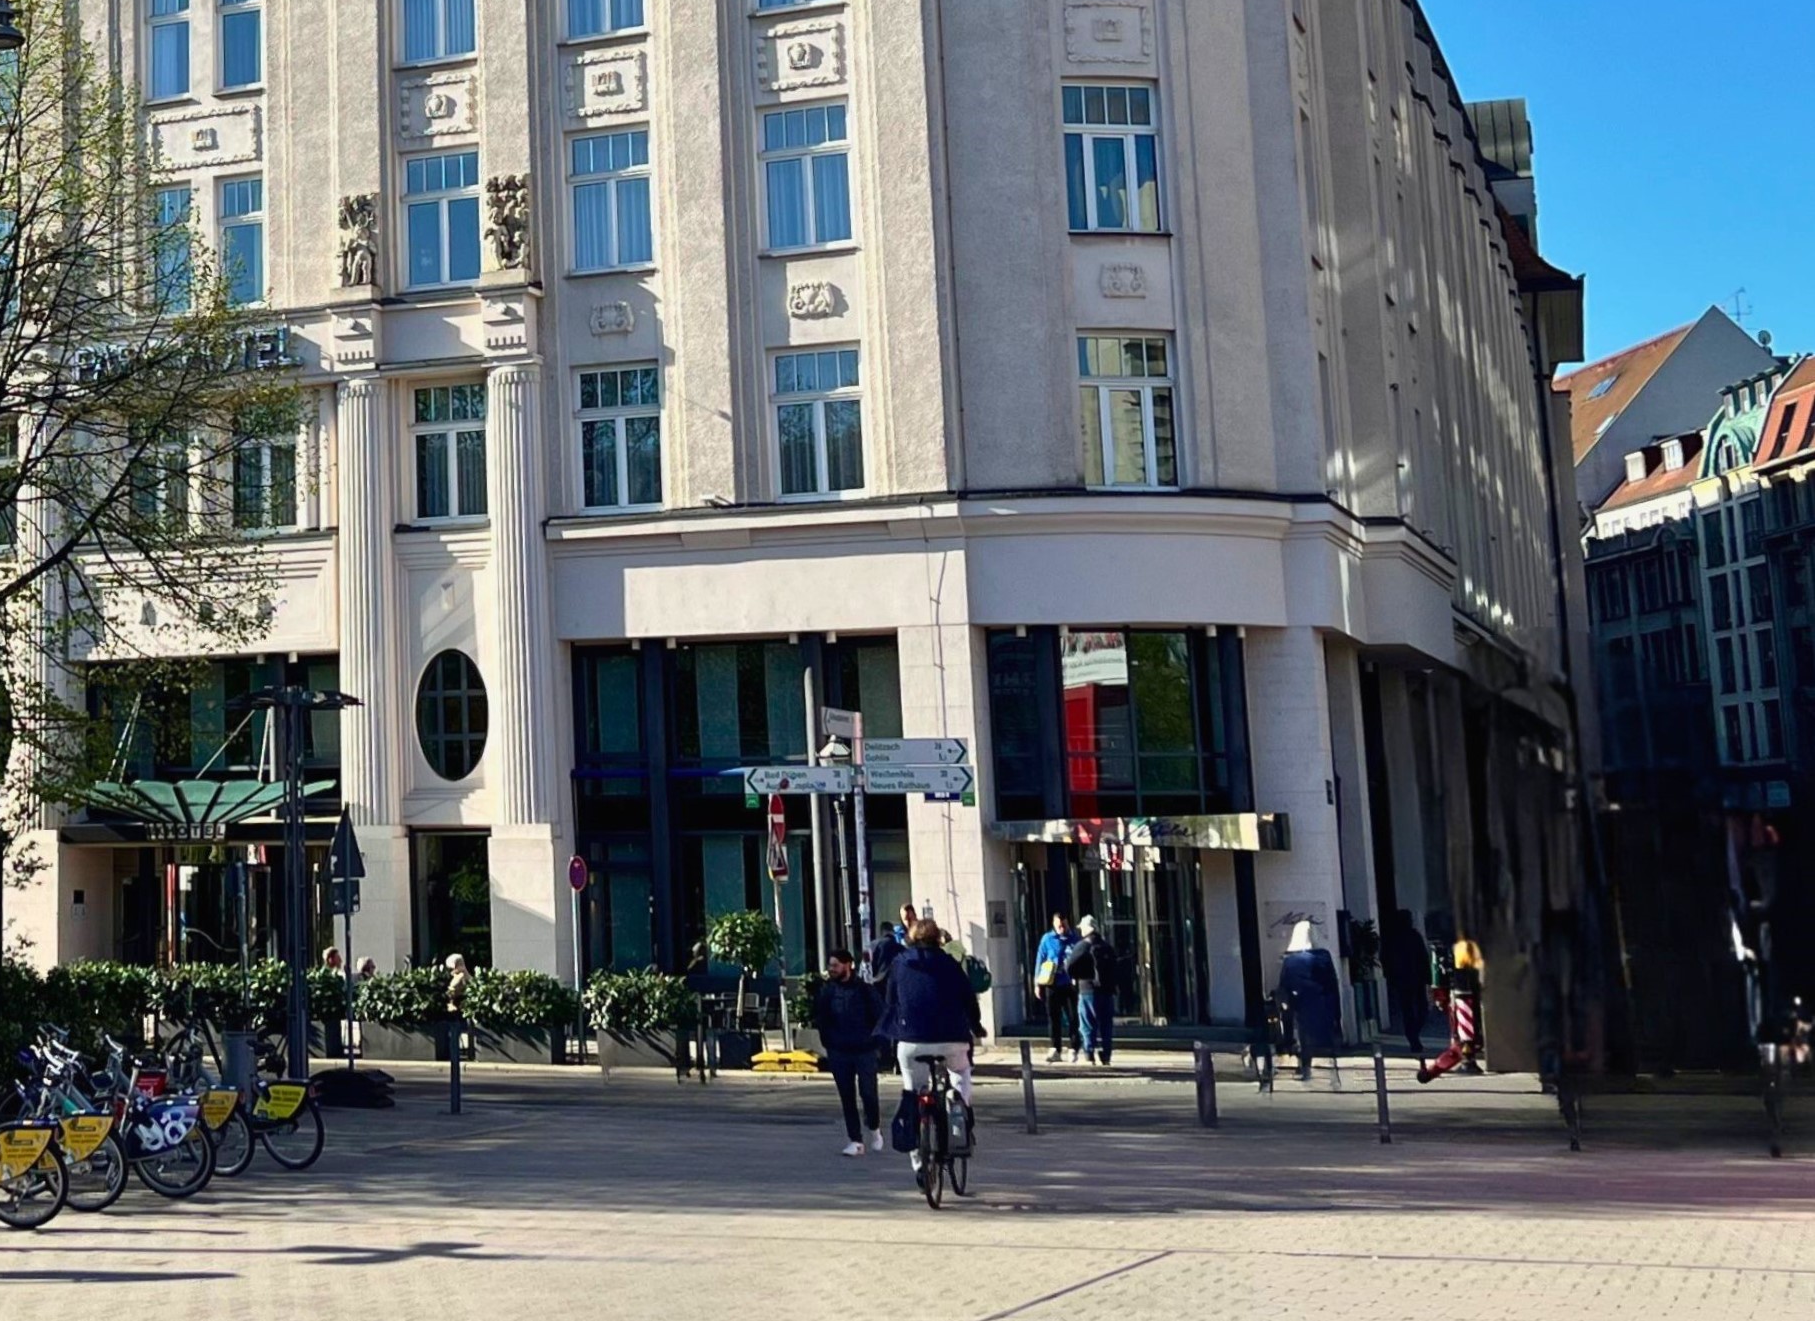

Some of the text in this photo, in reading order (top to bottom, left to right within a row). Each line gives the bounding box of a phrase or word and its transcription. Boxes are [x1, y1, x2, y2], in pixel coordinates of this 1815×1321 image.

[864, 753, 890, 761] Gohlis
[870, 781, 897, 789] Neues
[897, 781, 931, 789] Rathaus
[165, 822, 227, 840] HOTEL
